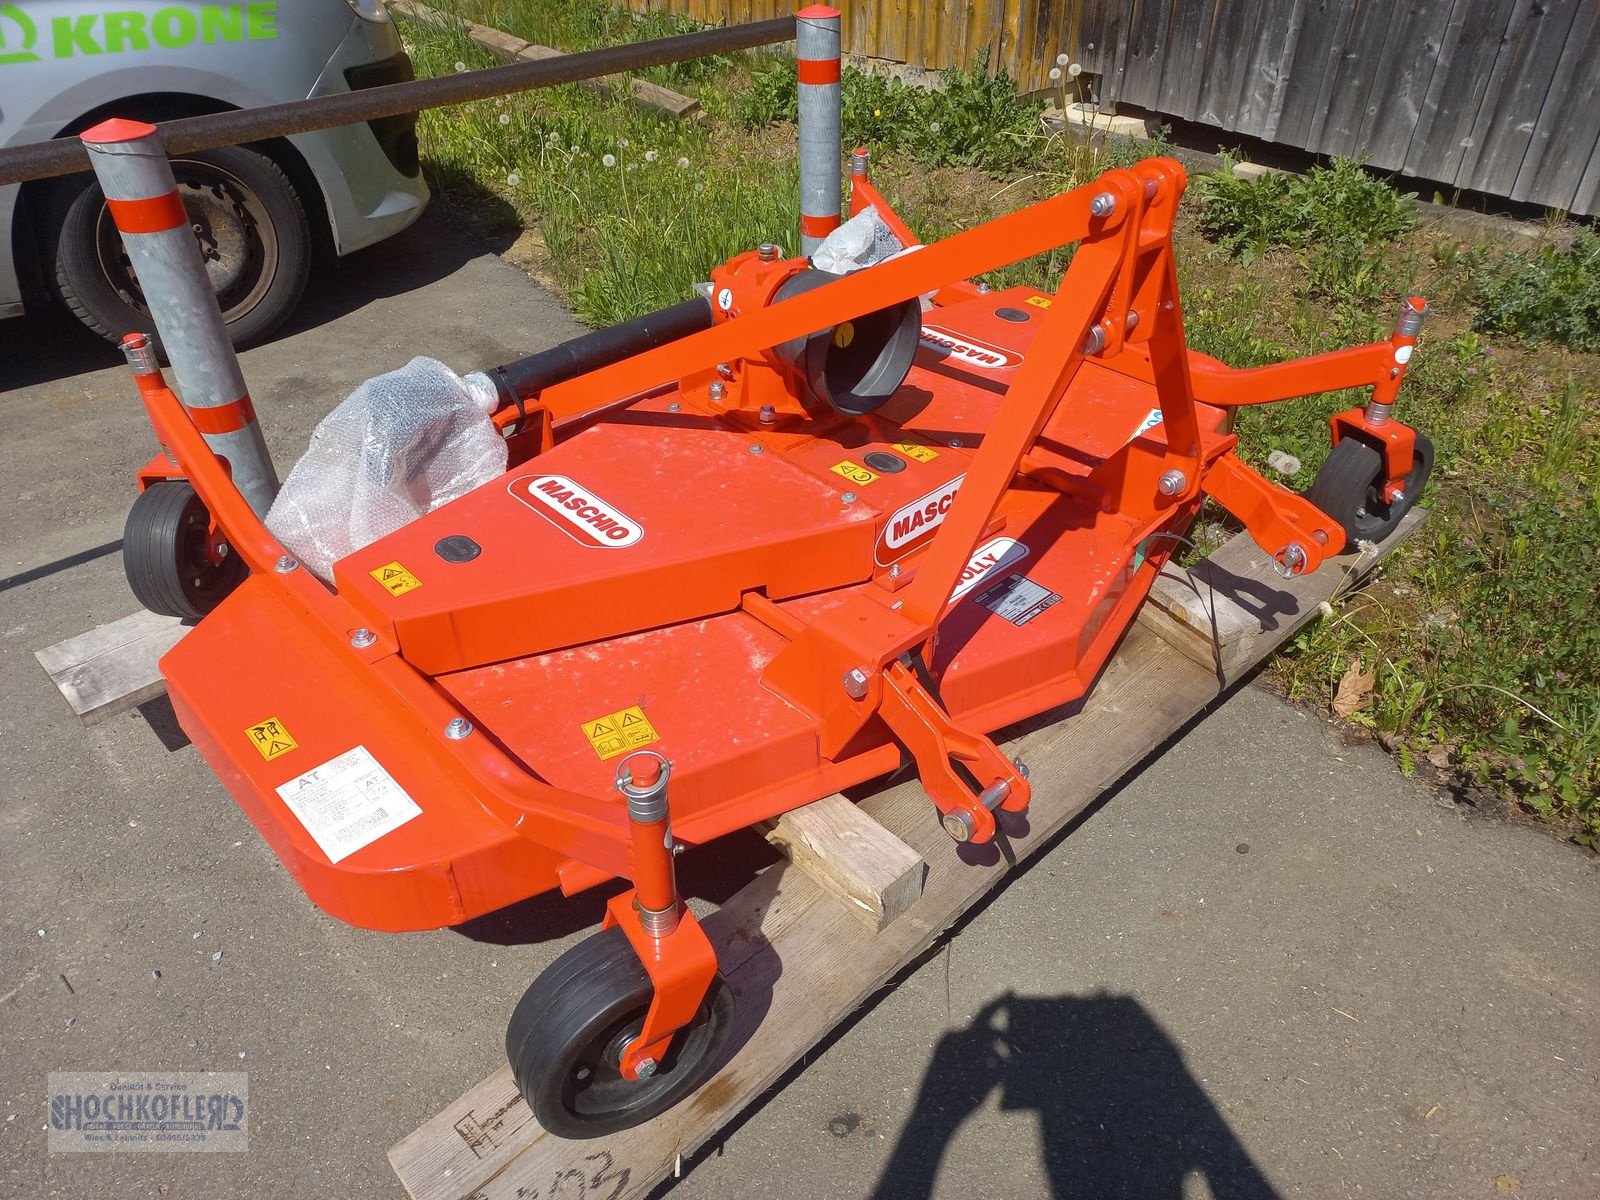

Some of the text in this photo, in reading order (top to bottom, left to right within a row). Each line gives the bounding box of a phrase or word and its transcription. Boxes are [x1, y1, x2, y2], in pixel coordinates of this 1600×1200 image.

[51, 2, 278, 58] KRONE
[536, 479, 630, 540] MASCHIO
[893, 489, 958, 542] MASC
[299, 771, 320, 790] AT
[366, 775, 379, 787] AT
